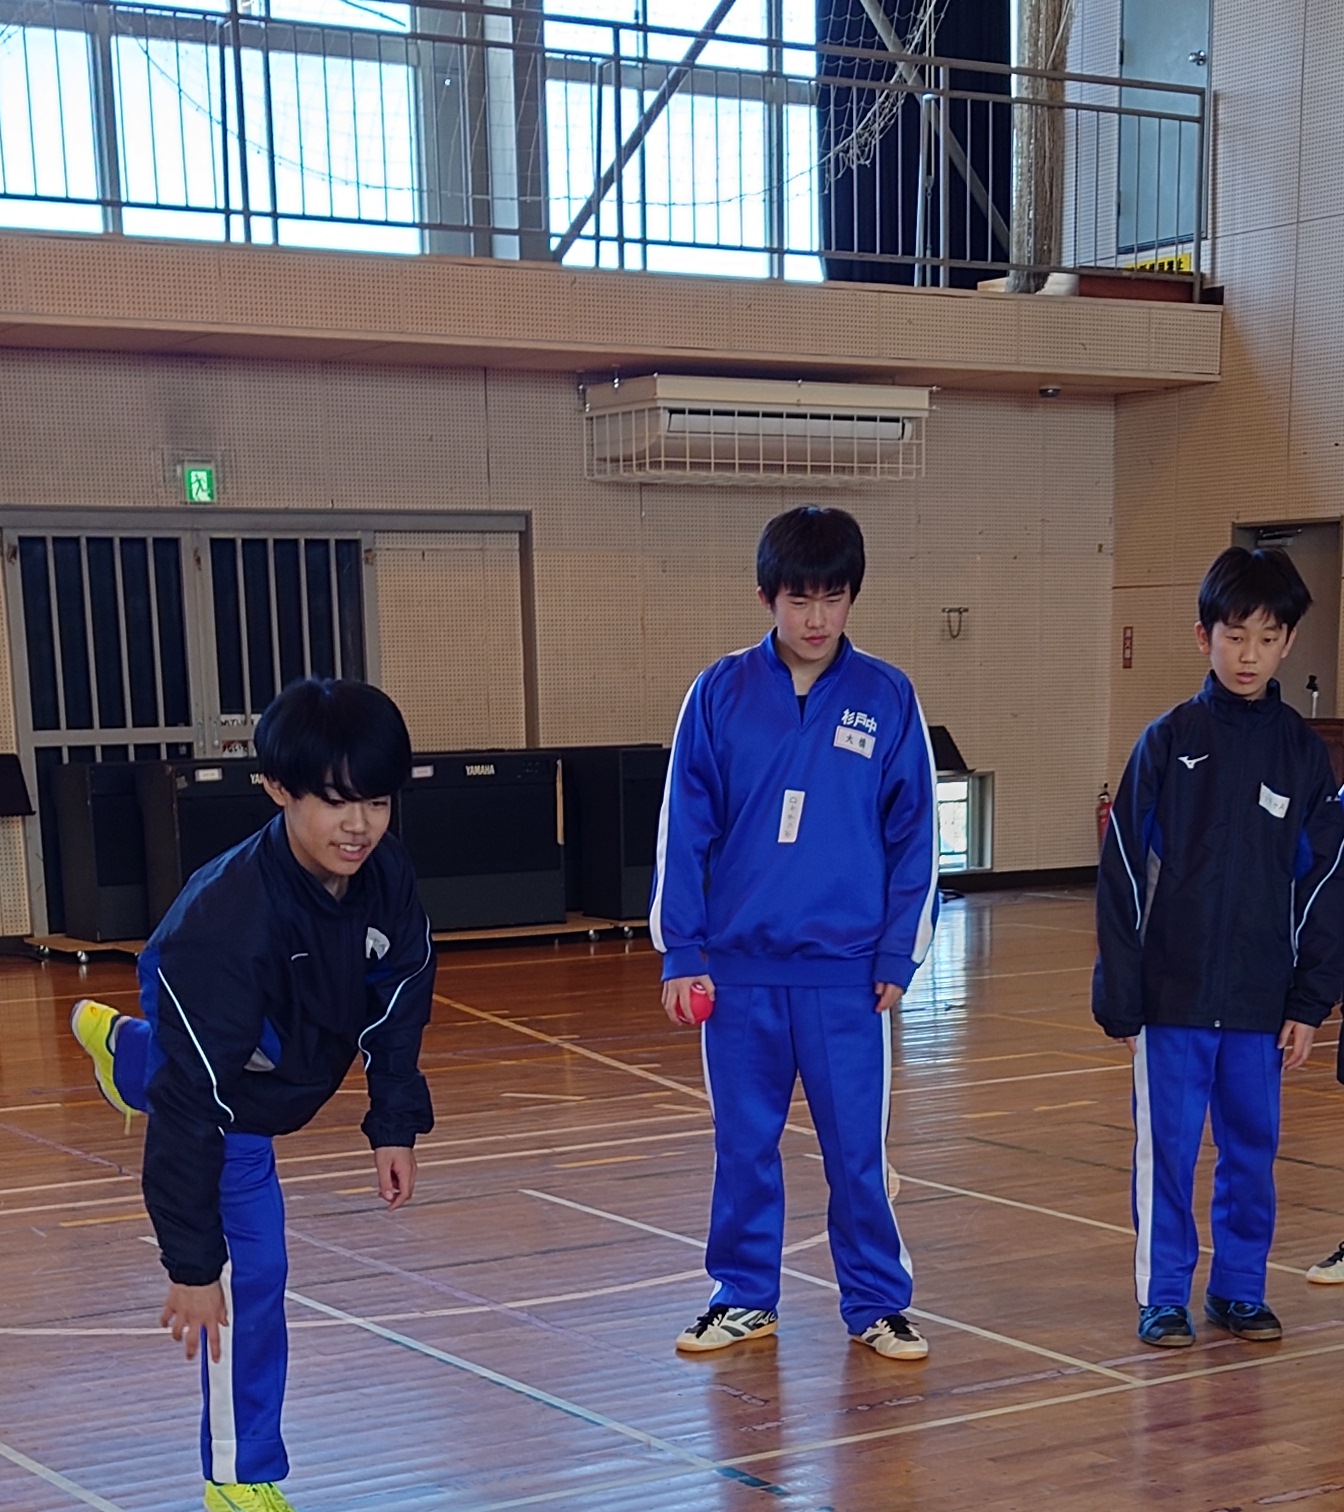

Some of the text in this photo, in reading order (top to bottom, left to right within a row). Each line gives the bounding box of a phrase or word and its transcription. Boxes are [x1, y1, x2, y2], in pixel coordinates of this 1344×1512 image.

[841, 708, 878, 733] 杉戸中
[465, 764, 496, 776] YAMAHA
